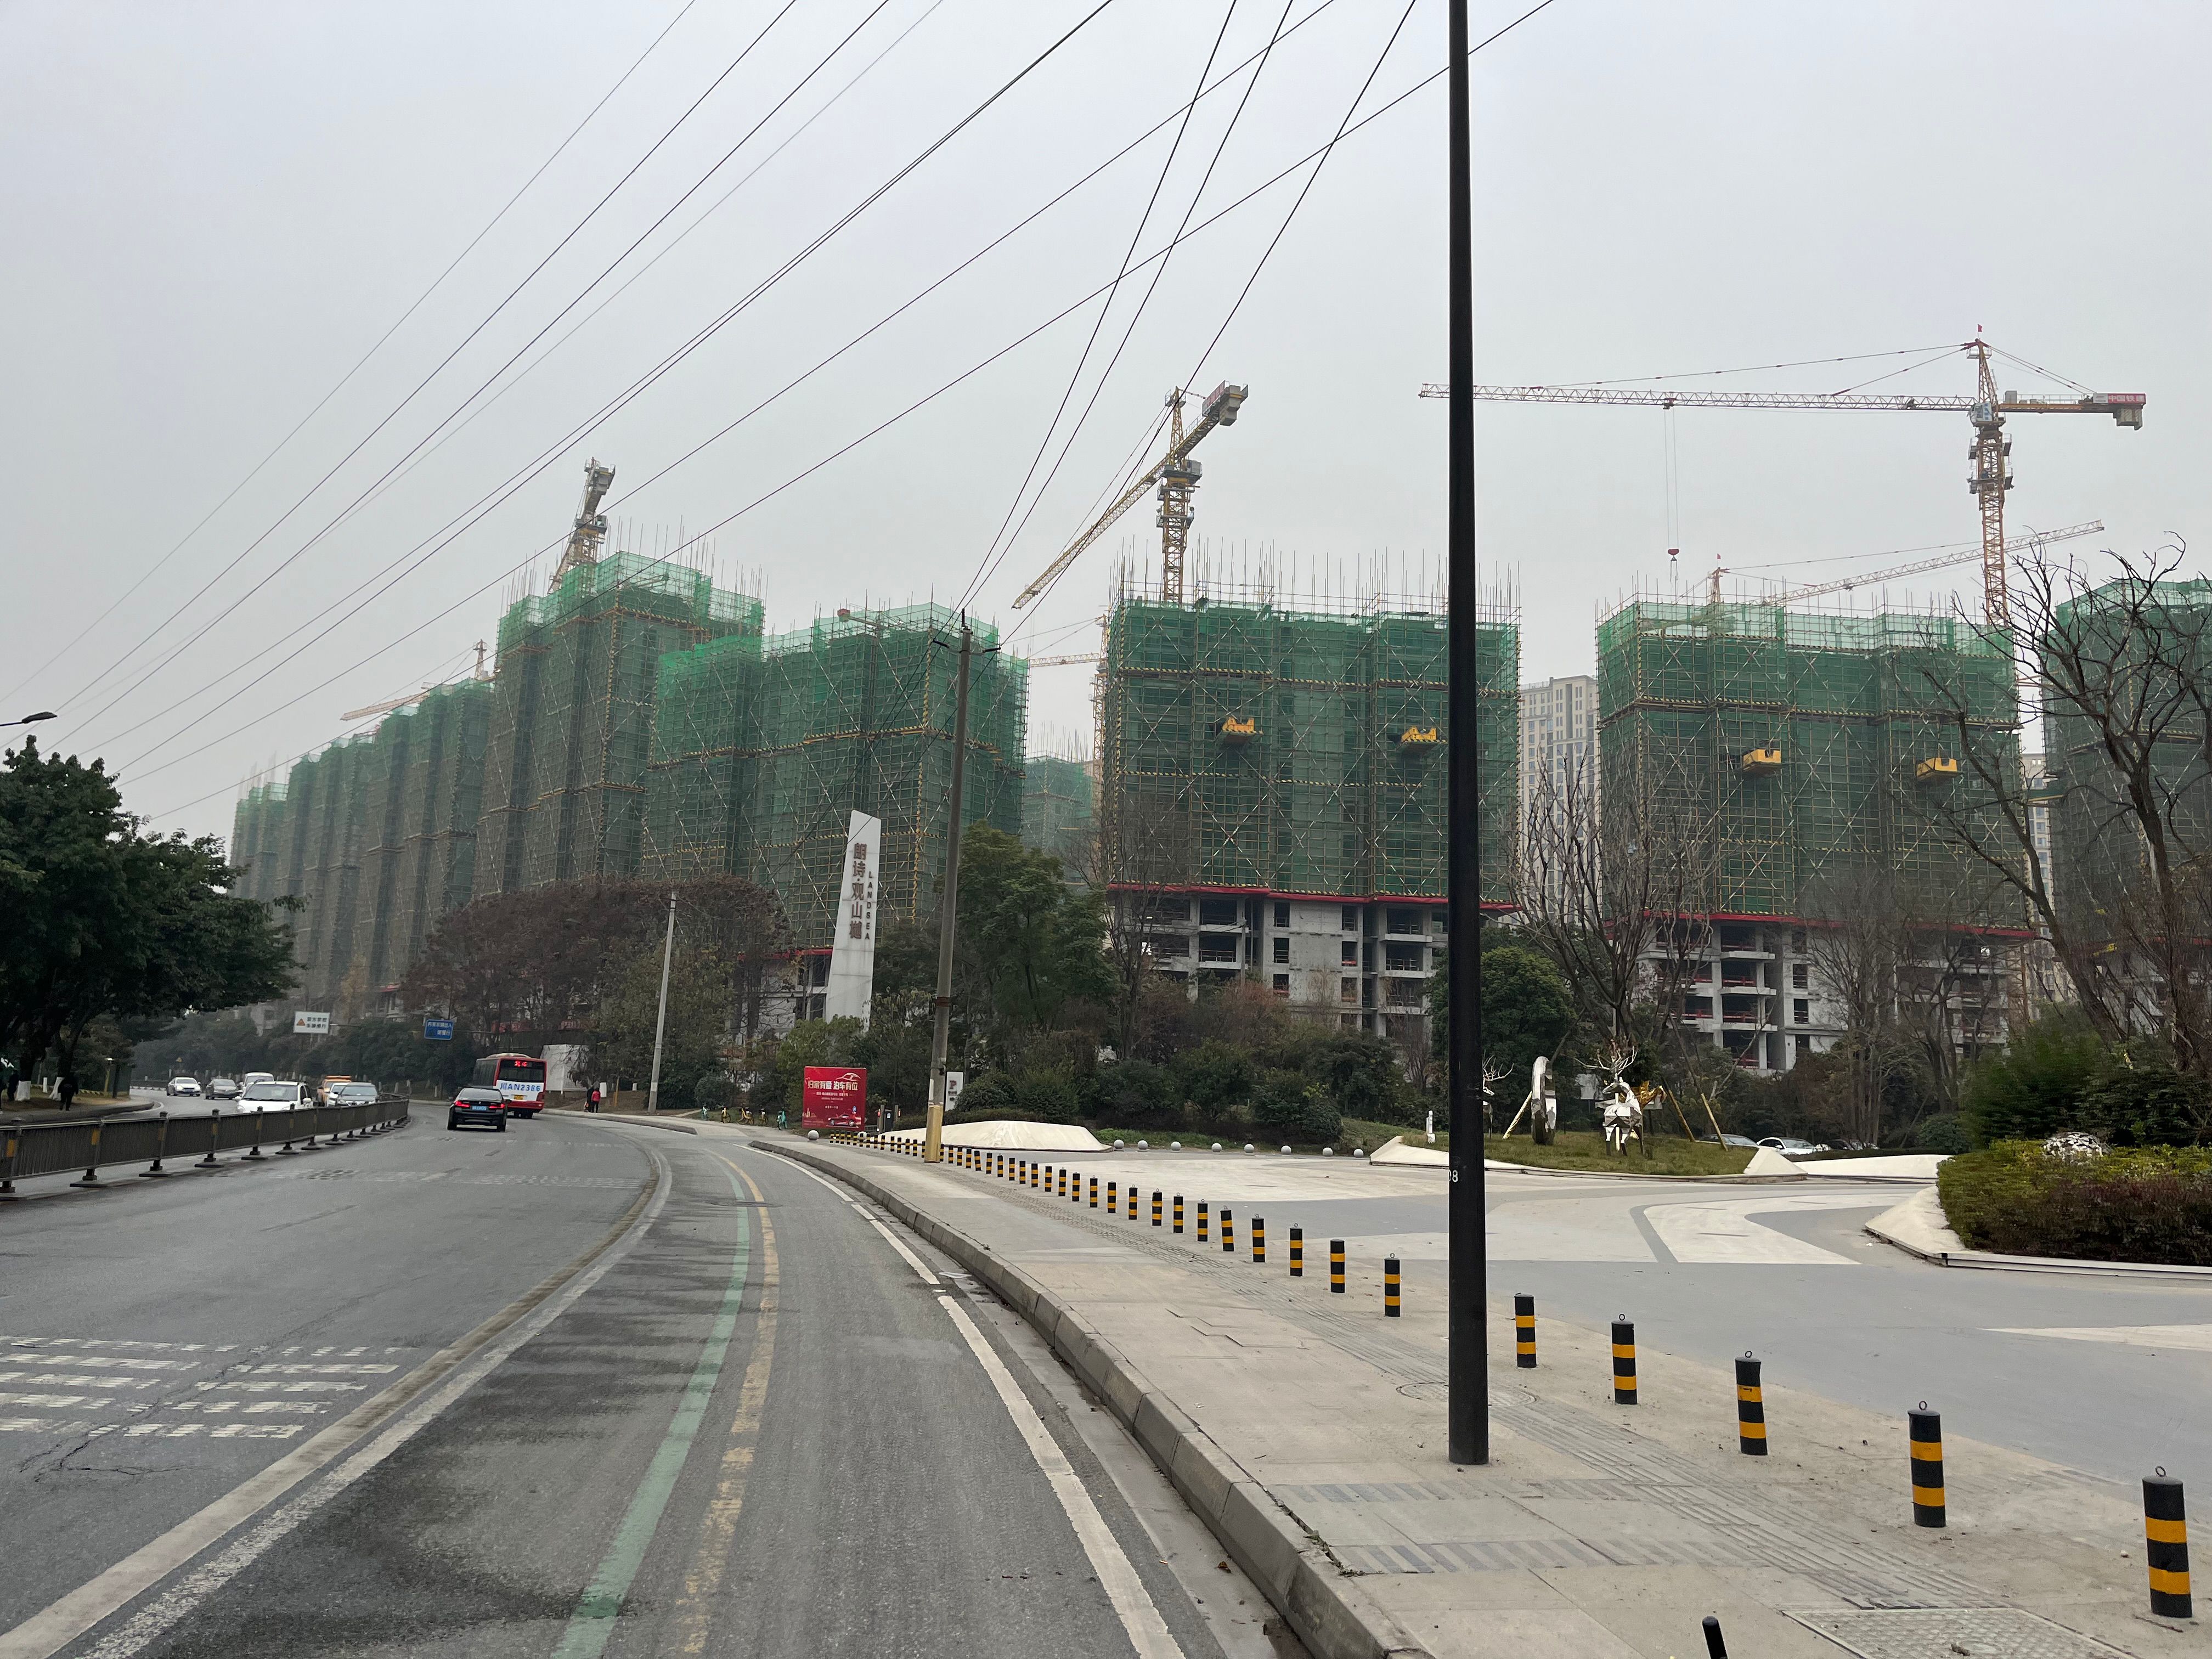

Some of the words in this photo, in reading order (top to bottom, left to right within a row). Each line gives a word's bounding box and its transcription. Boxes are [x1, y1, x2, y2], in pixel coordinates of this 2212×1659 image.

[865, 871, 873, 940] LANDSEA
[500, 1082, 540, 1092] 川AN2386
[833, 1081, 858, 1091] 泊车有位
[950, 1080, 957, 1089] P
